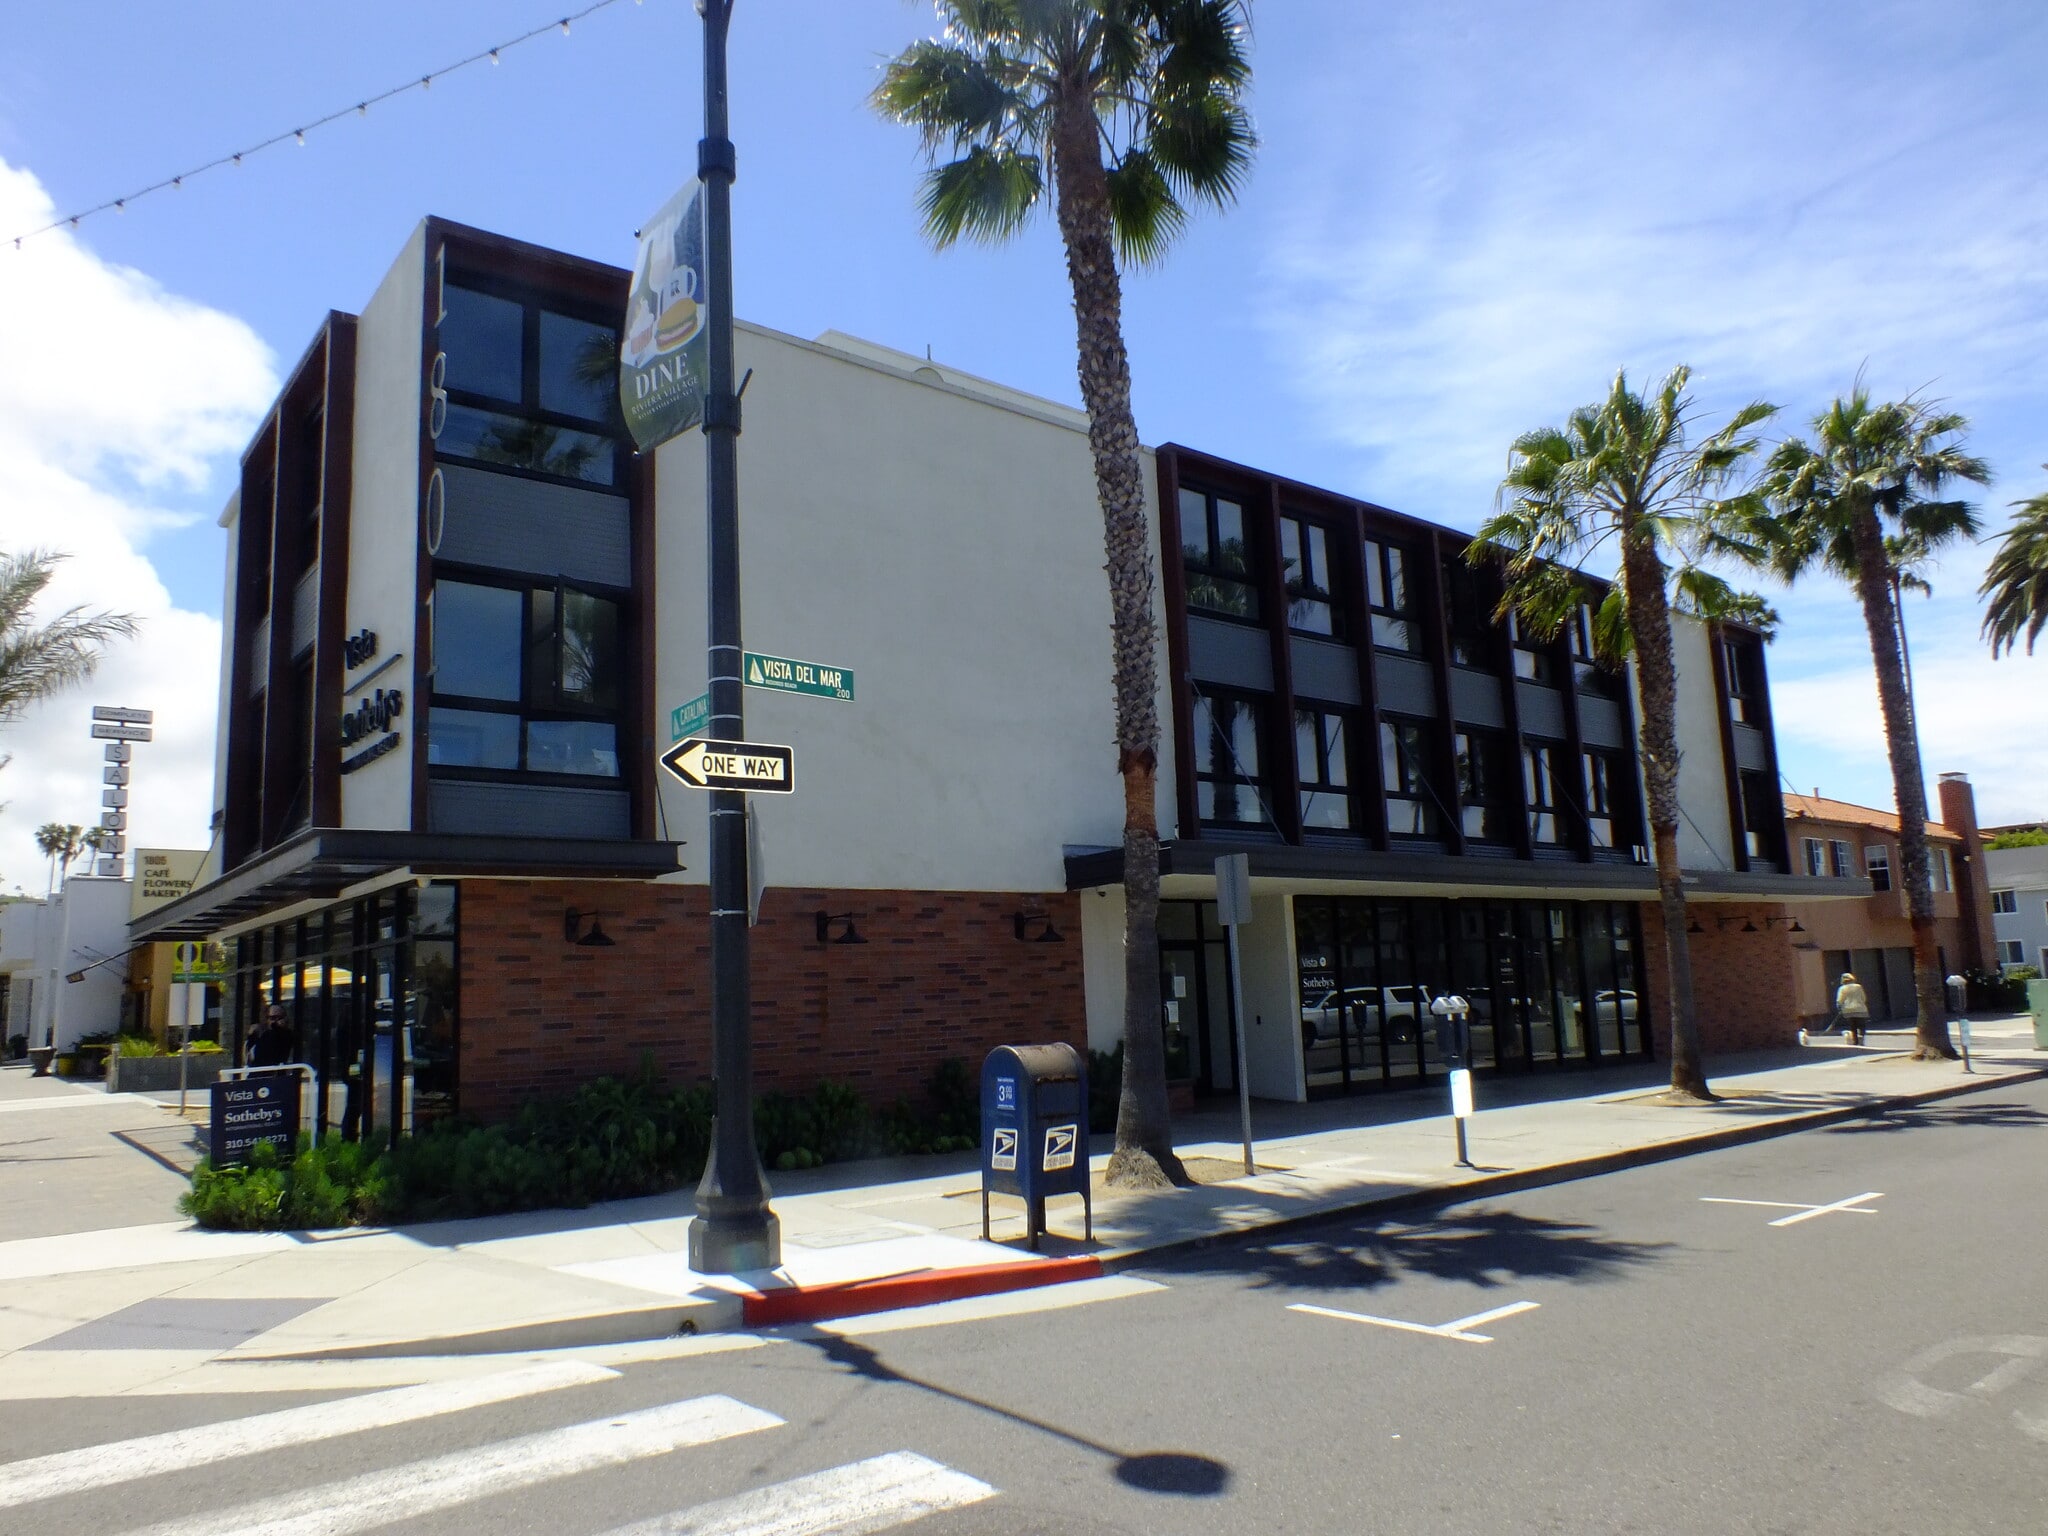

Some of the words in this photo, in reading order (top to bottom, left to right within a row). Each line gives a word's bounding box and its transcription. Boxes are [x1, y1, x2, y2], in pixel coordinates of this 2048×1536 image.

[635, 352, 689, 399] DINE
[763, 659, 792, 680] VISTA
[796, 665, 817, 685] DEL
[820, 669, 842, 688] MAR
[836, 688, 851, 699] 200
[97, 728, 146, 737] SERVICE
[702, 755, 737, 775] ONE
[743, 758, 778, 777] WAY
[106, 746, 122, 850] SALON
[144, 880, 192, 888] FLOWERS
[143, 889, 182, 897] BAKERY
[1302, 957, 1318, 967] Vista
[225, 1090, 254, 1102] Vista
[999, 1085, 1005, 1101] 3
[224, 1108, 282, 1123] Sotheby's
